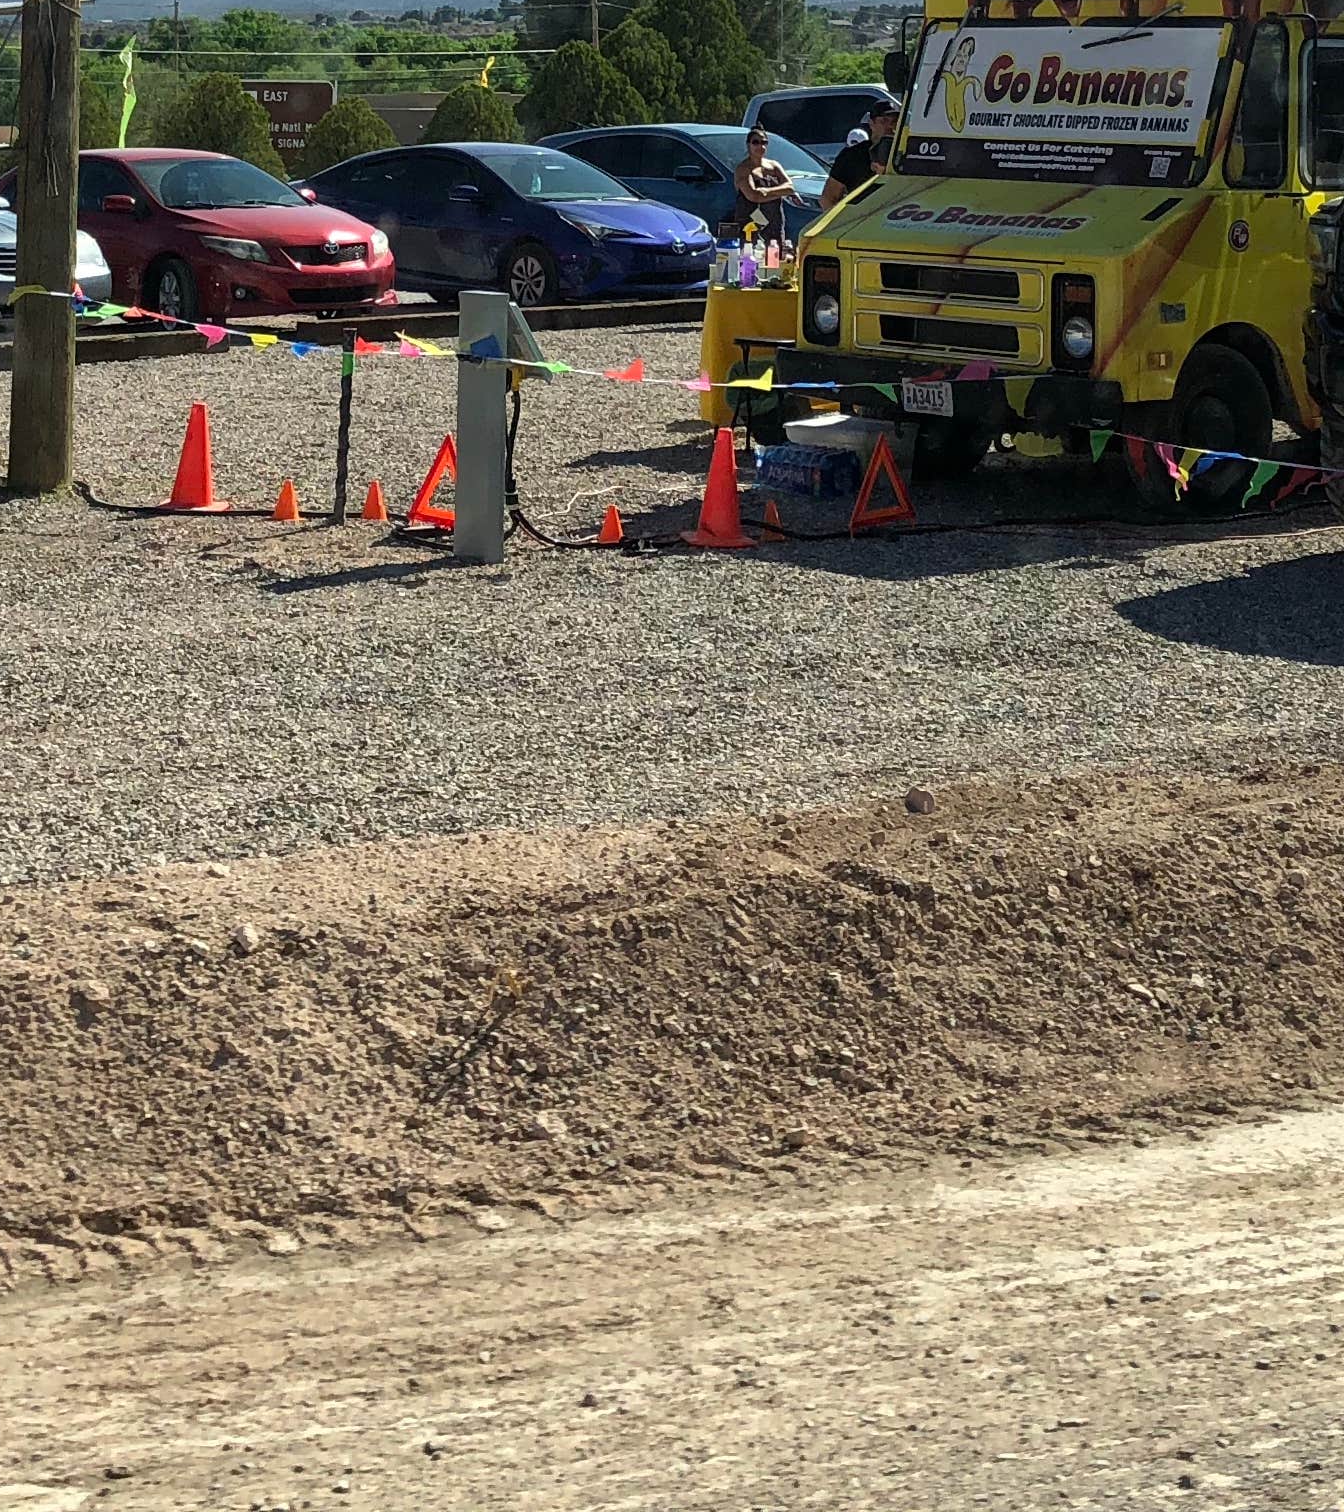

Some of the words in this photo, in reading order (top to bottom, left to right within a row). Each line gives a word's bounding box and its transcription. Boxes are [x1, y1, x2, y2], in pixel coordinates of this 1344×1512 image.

[983, 53, 1032, 105] Go
[1033, 54, 1189, 107] Bananas
[263, 90, 288, 102] EAST
[1013, 113, 1063, 129] CHOCOLATE
[1065, 115, 1100, 130] DIPPED
[1102, 116, 1139, 131] FROZEN
[1140, 117, 1190, 133] BANANAS
[277, 138, 305, 148] SIGNA
[983, 142, 1027, 152] Contact
[1028, 143, 1041, 152] Us
[1042, 144, 1062, 153] For
[1063, 145, 1113, 156] Catering
[886, 203, 934, 221] Go
[934, 206, 1087, 230] Bananas
